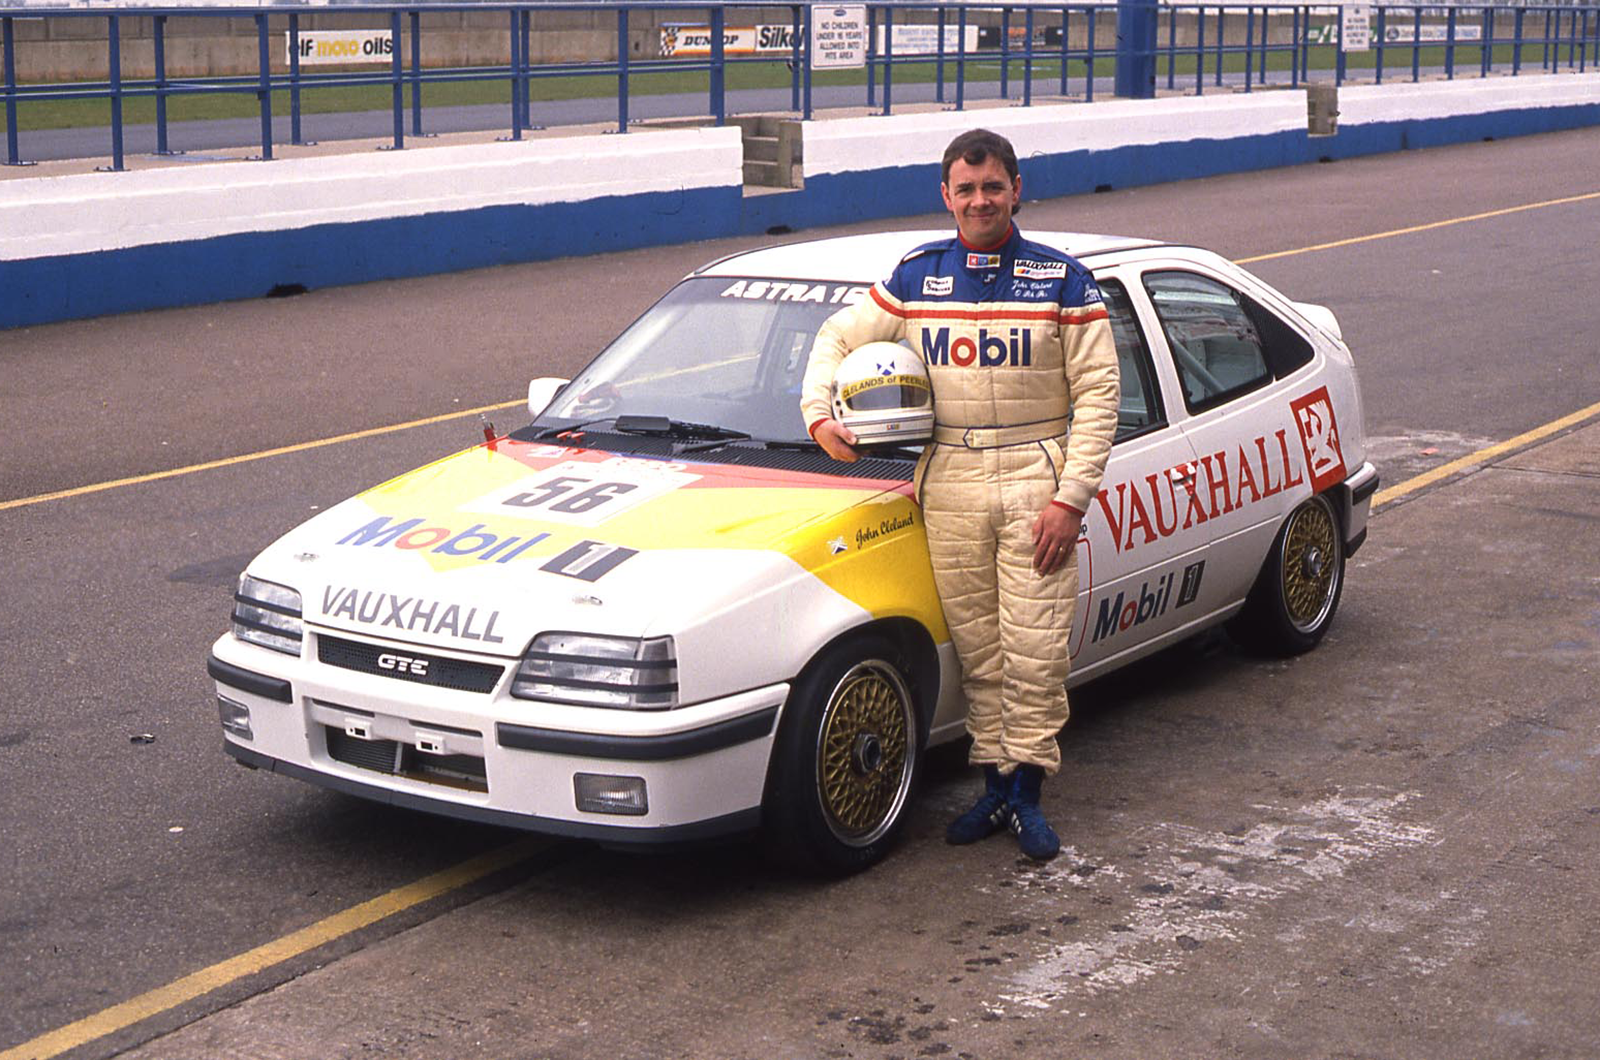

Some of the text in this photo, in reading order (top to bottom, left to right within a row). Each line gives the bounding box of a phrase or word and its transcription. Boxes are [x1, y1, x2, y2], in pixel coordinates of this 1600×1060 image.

[317, 41, 359, 57] moto
[363, 37, 393, 55] oils
[683, 35, 739, 46] DUNOP
[1016, 260, 1063, 270] VAUXHALL
[720, 280, 827, 303] ASTRA
[921, 327, 1031, 366] Mobil
[843, 376, 885, 399] CLELANDS
[501, 476, 639, 514] 56
[1095, 428, 1304, 555] VAUXHALL
[335, 516, 552, 564] Mobil
[855, 511, 914, 550] John Cleland
[321, 584, 505, 644] VAUXHALL
[1091, 572, 1174, 644] Mobil
[378, 653, 429, 676] GTE
